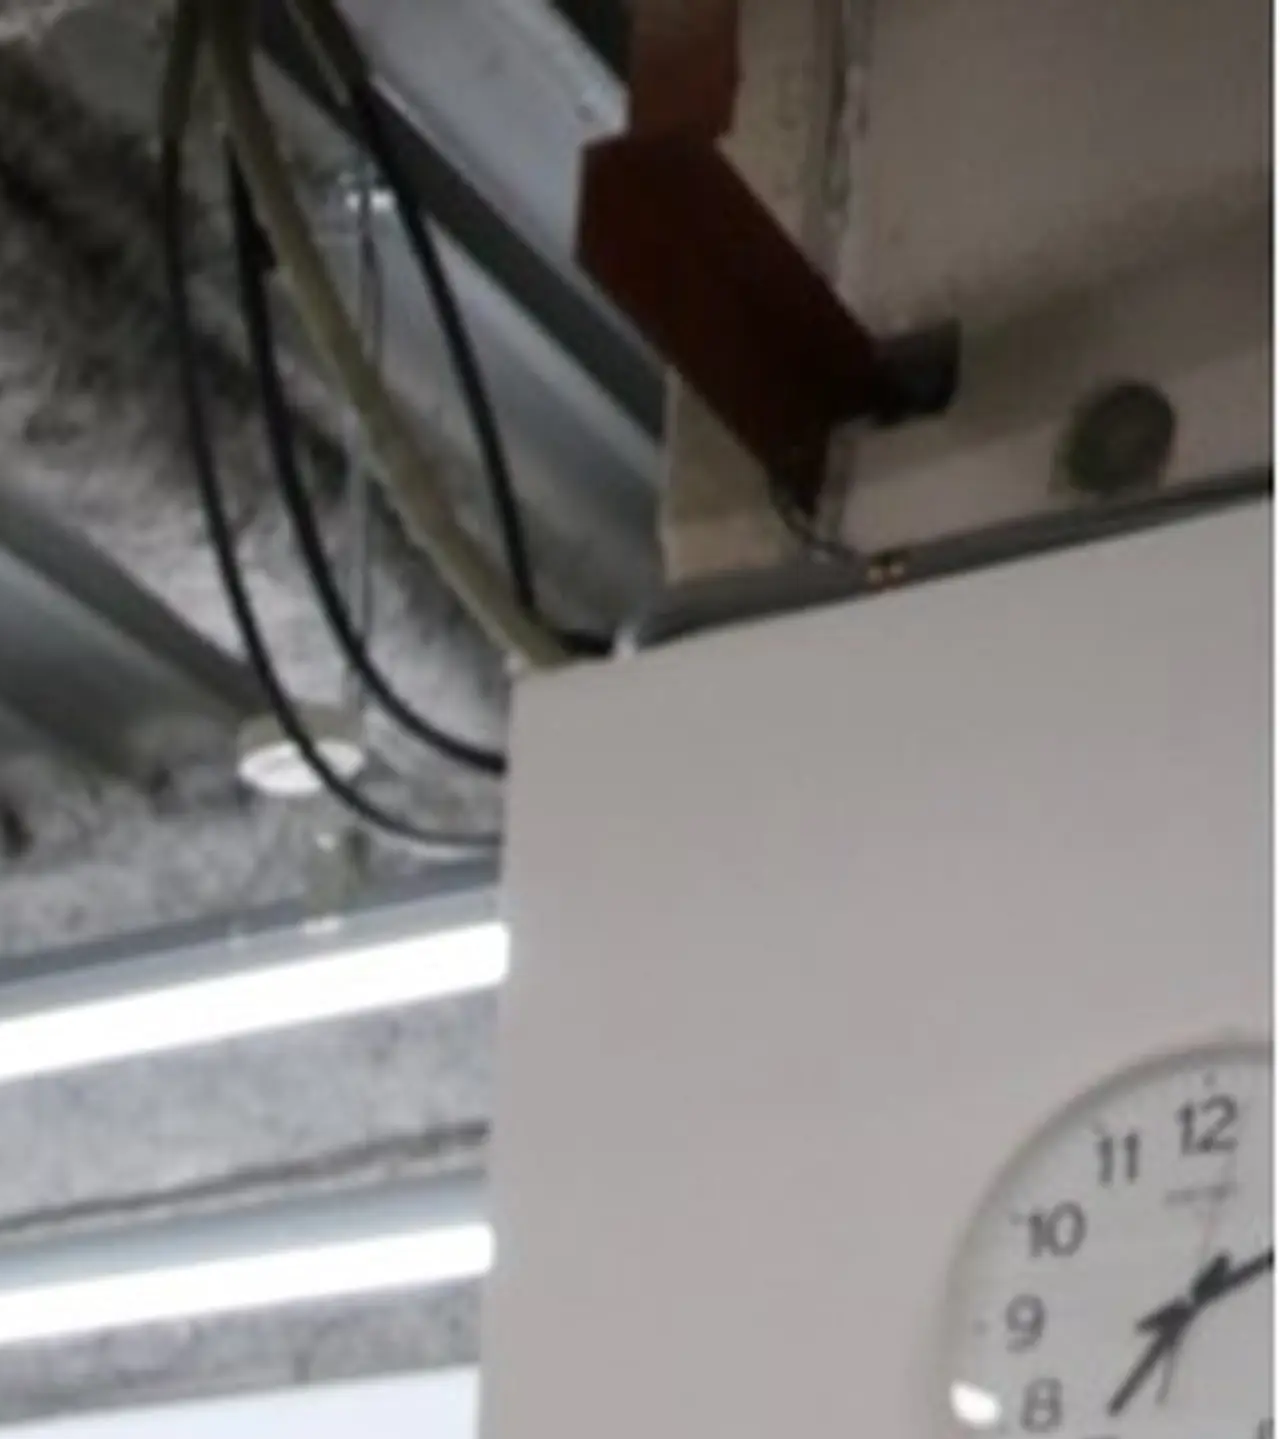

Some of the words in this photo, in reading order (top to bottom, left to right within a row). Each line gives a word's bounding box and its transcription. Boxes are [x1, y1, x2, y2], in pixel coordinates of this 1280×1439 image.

[1177, 1094, 1239, 1155] 12
[1097, 1132, 1140, 1187] 11
[1027, 1201, 1086, 1257] 10
[1006, 1294, 1046, 1352] 9
[1020, 1377, 1063, 1433] 8
